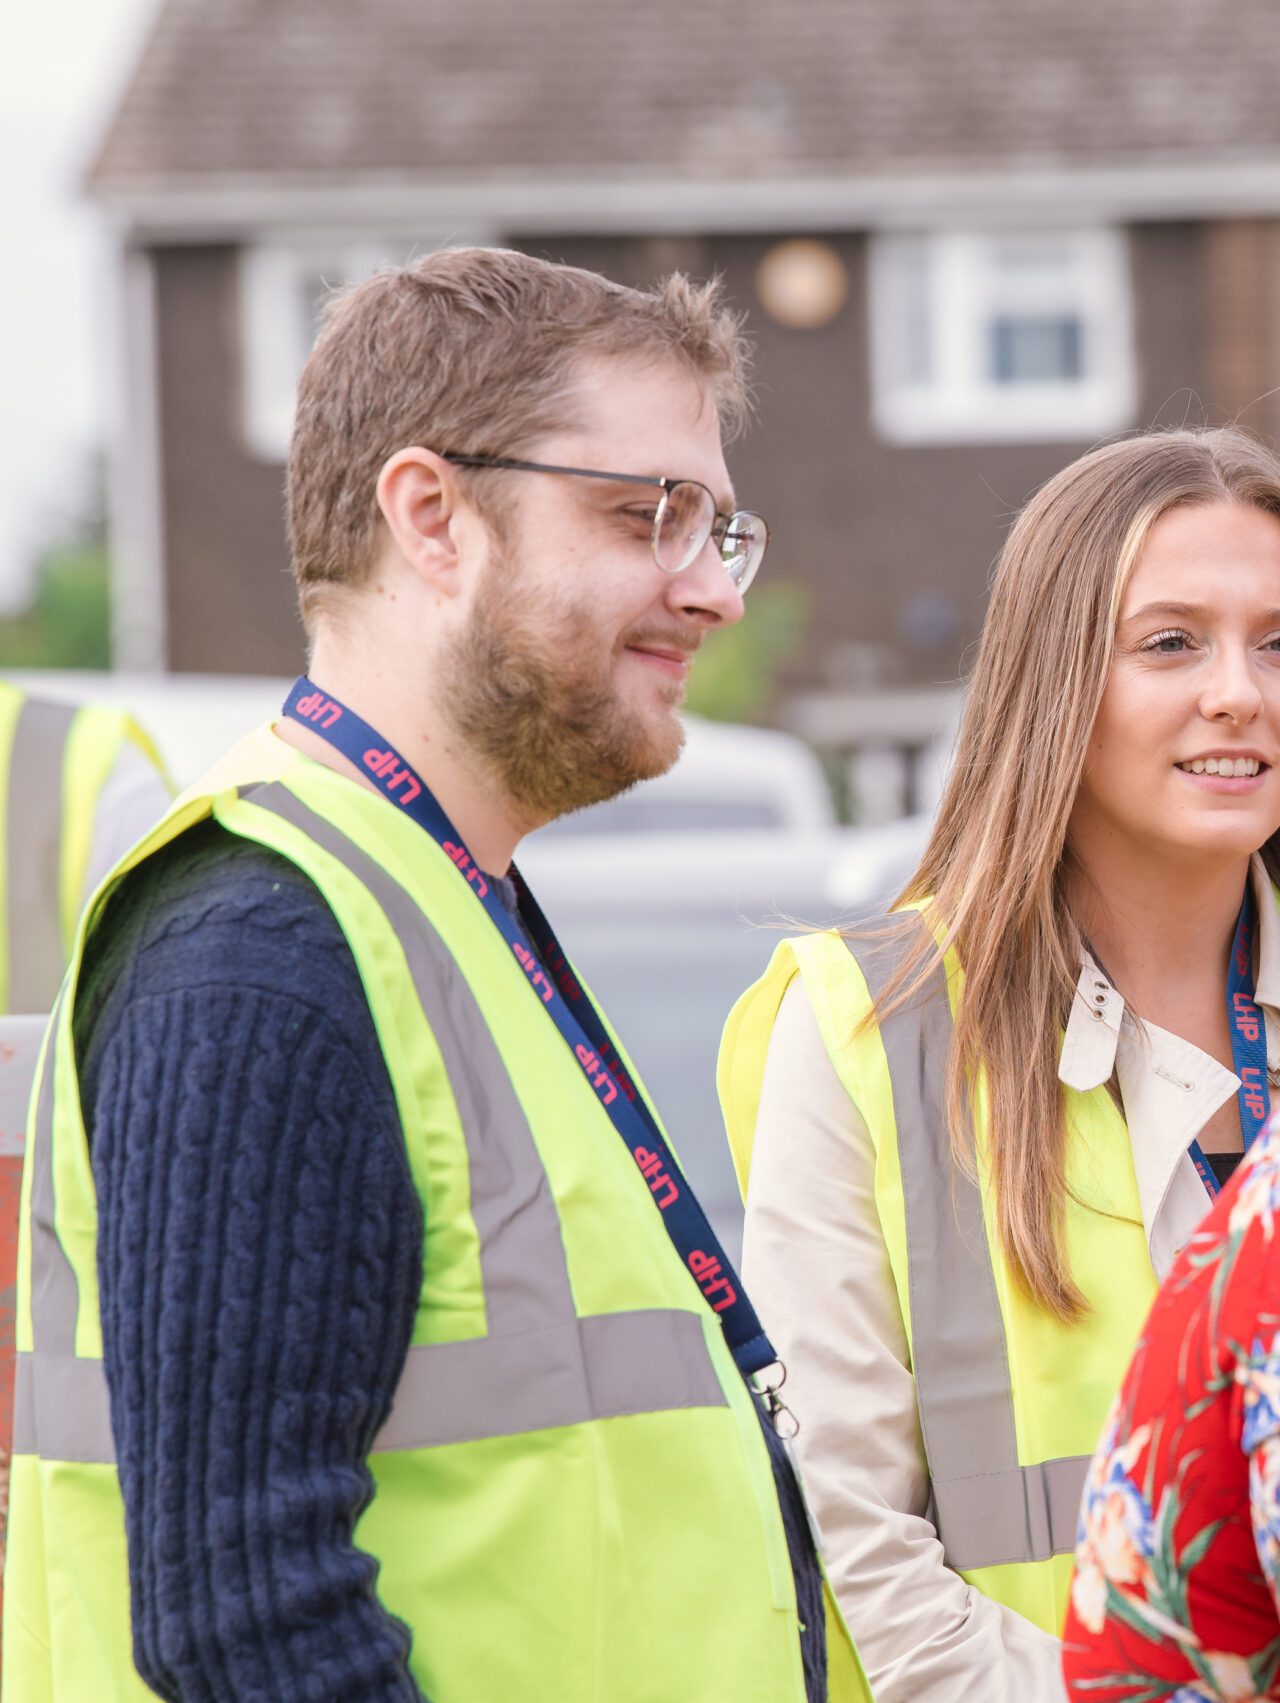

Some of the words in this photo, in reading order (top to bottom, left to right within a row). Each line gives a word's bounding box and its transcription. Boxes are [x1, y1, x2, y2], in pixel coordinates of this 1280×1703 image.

[295, 692, 343, 729] LHP
[362, 748, 422, 805] LHP
[442, 841, 488, 898] LHP
[512, 942, 554, 1002] LHP
[1233, 992, 1259, 1041] LHP
[575, 1043, 618, 1105] LHP
[1241, 1066, 1265, 1120] LHP
[634, 1145, 679, 1210] LHP
[688, 1249, 737, 1313] LHP
